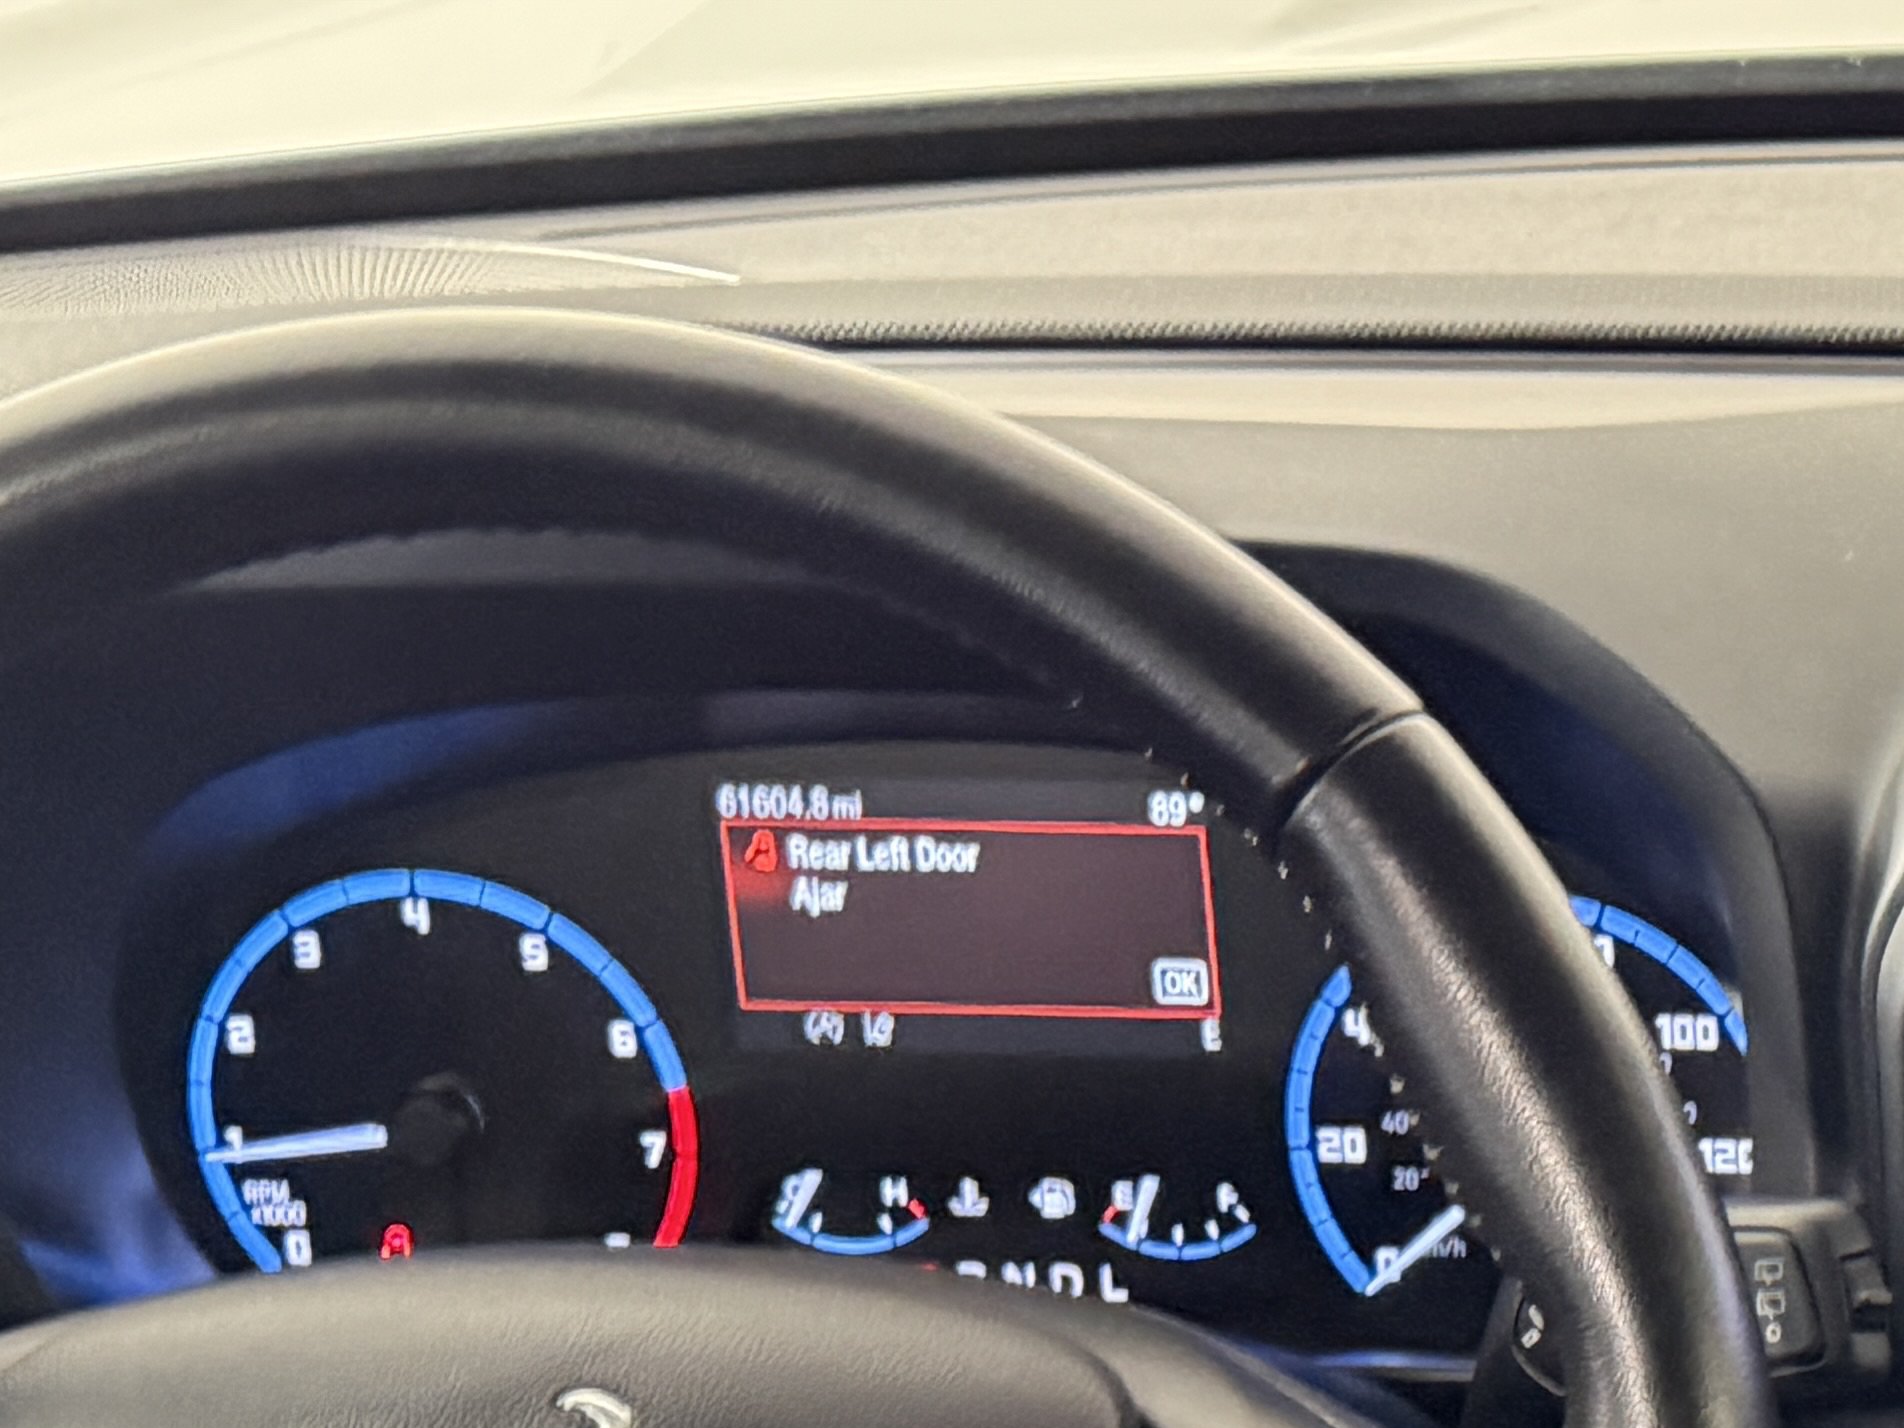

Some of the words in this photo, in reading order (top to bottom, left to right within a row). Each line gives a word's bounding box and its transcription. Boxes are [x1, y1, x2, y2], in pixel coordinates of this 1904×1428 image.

[786, 833, 850, 870] Rear
[856, 835, 909, 872] Left
[915, 835, 980, 872] Door
[402, 898, 429, 935] 4
[790, 876, 848, 918] Ajar
[1163, 971, 1198, 997] OK
[1654, 1012, 1720, 1051] 100
[639, 1131, 667, 1168] 7
[1316, 1127, 1367, 1166] 20
